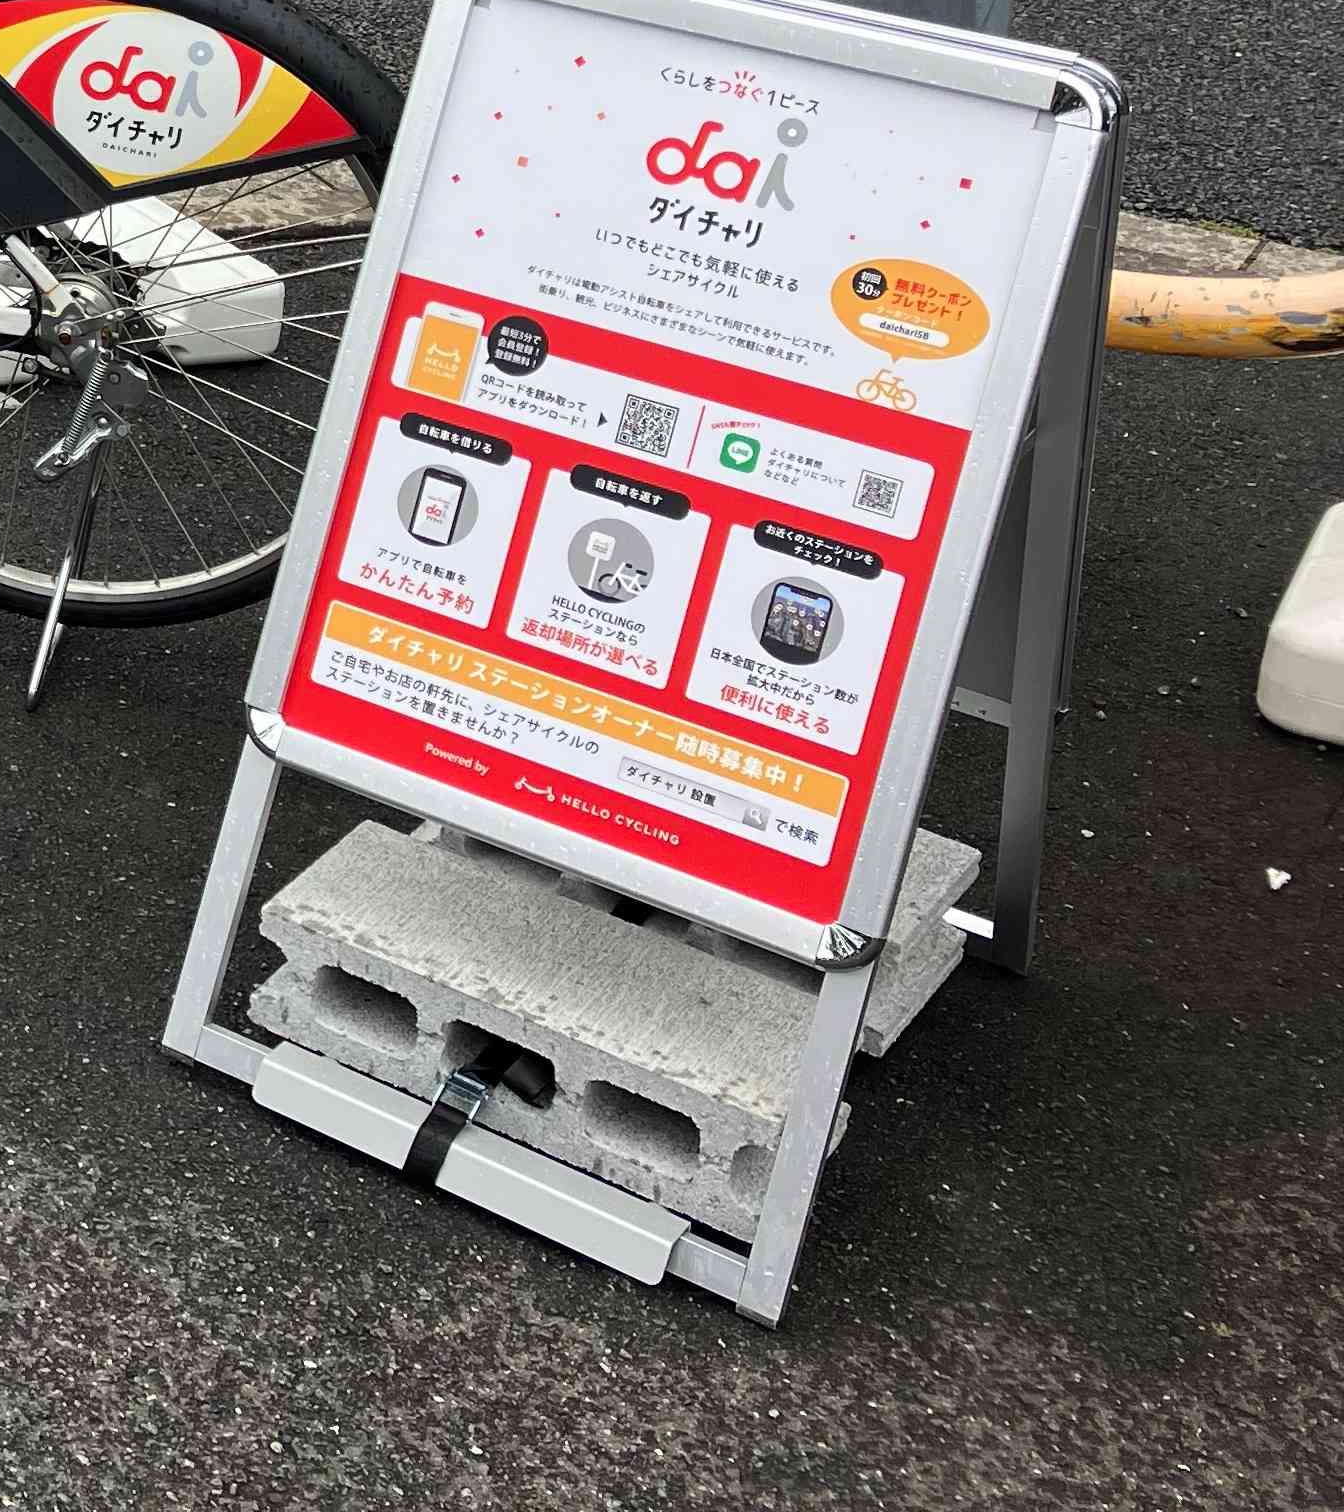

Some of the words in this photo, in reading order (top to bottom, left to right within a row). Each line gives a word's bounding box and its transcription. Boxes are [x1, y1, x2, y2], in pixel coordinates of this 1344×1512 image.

[659, 66, 820, 115] くらしをつなぐ1ピース
[85, 110, 183, 149] ダイチャリ
[648, 197, 765, 249] ダイチャリ
[595, 228, 800, 293] いつでもどこでも気軽に使える
[647, 264, 740, 300] シェアサイクル
[894, 278, 972, 307] 無料クーポン
[481, 373, 588, 412] QRコードを読み取って
[418, 423, 493, 454] 自転車を借りる
[595, 478, 663, 506] 自転車を返す
[765, 523, 874, 566] お近くのステーションを
[376, 546, 467, 585] アプリで自転車を
[360, 562, 474, 614] かんたん予約
[548, 608, 638, 646] ステーションなら
[552, 596, 586, 614] HELLO
[588, 607, 646, 633] CYCLINGの
[521, 616, 658, 676] 返却場所が選べる
[710, 647, 858, 705] 日本全国でステーション数が
[747, 673, 816, 706] 拡大中だから
[325, 666, 519, 744] ステーションを置きませんか？
[331, 649, 600, 755] ご自宅やお店の軒先に、シェアサイクルの
[720, 684, 830, 735] 便利に使える
[424, 742, 473, 769] Powered
[471, 761, 490, 777] by
[561, 794, 611, 821] HELLO
[614, 813, 681, 846] CYCLING
[775, 818, 820, 846] で検索
